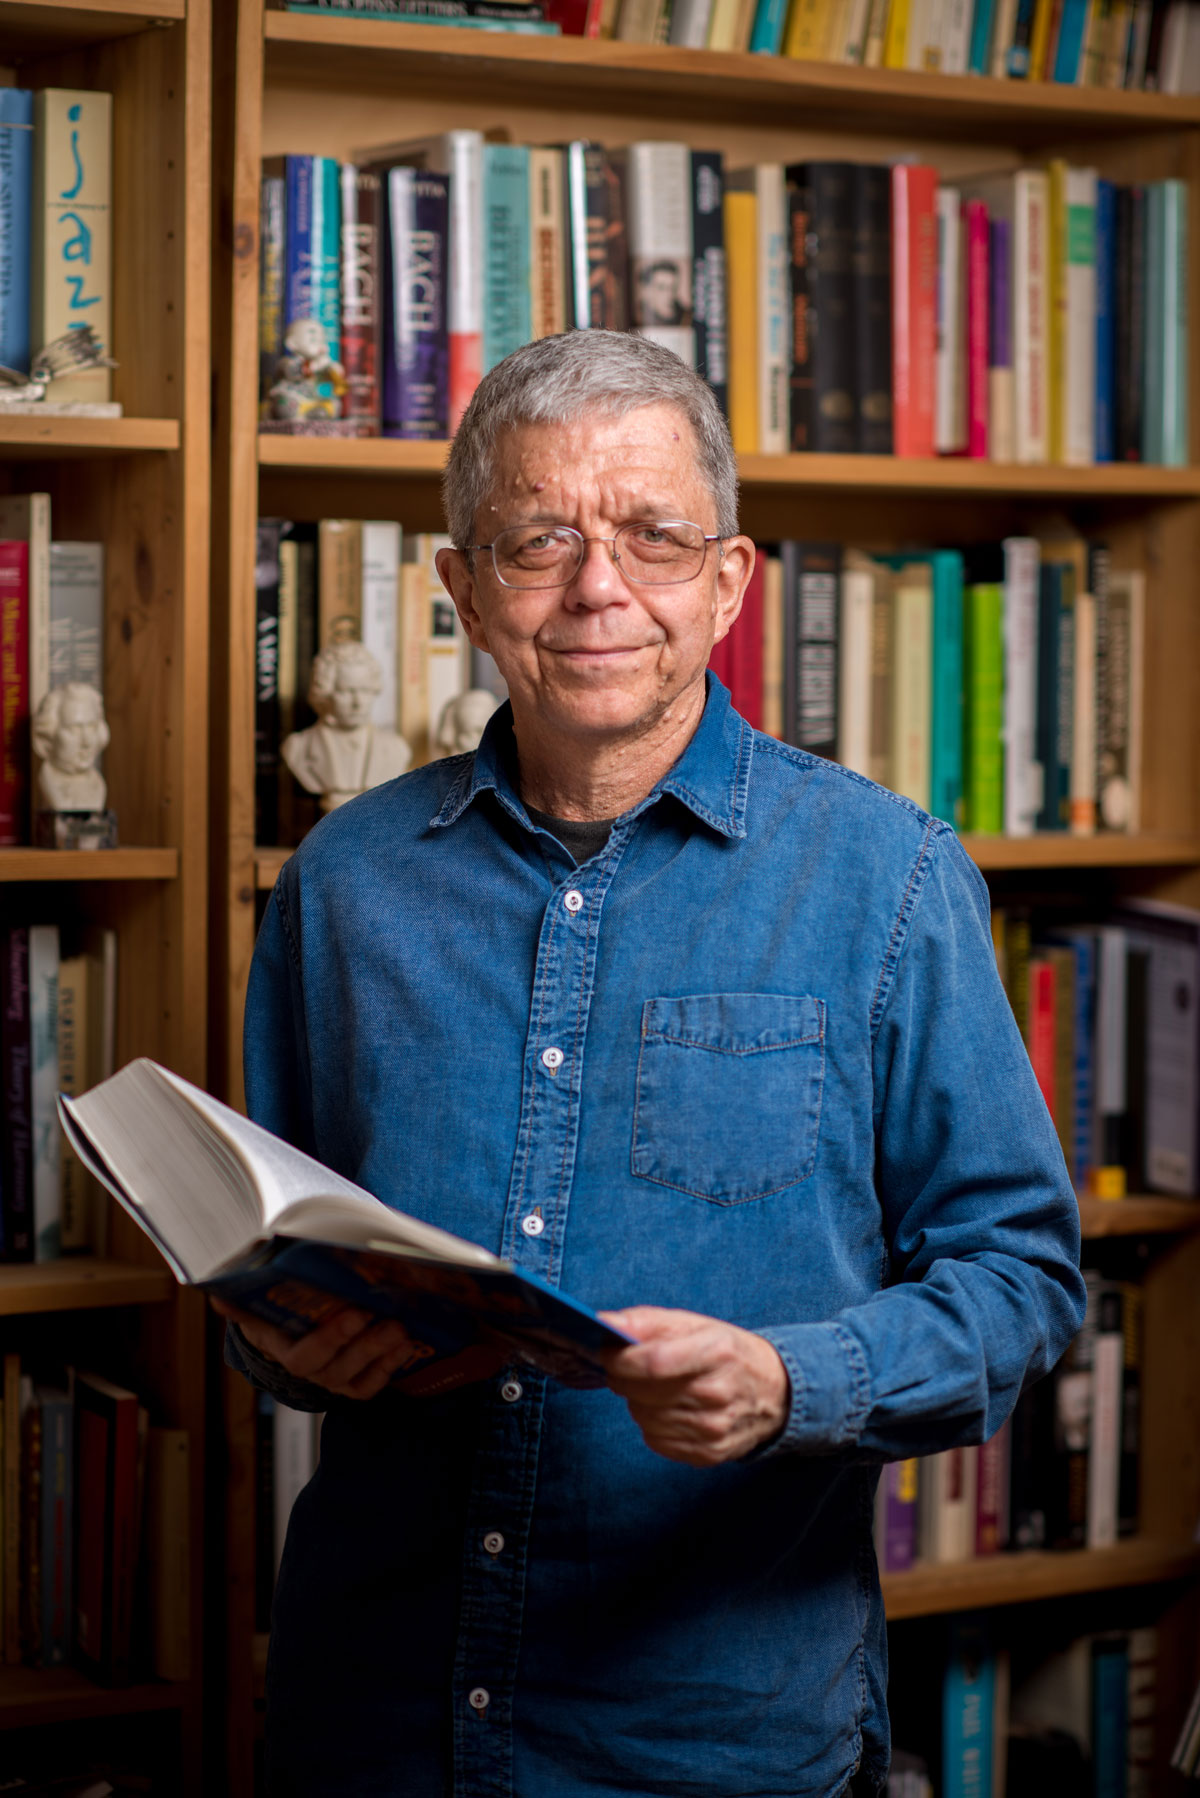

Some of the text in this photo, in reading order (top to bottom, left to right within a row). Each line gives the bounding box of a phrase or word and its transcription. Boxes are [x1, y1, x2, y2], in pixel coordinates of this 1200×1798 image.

[342, 223, 375, 326] BACH
[402, 231, 436, 332] BACH
[258, 612, 277, 702] AARON
